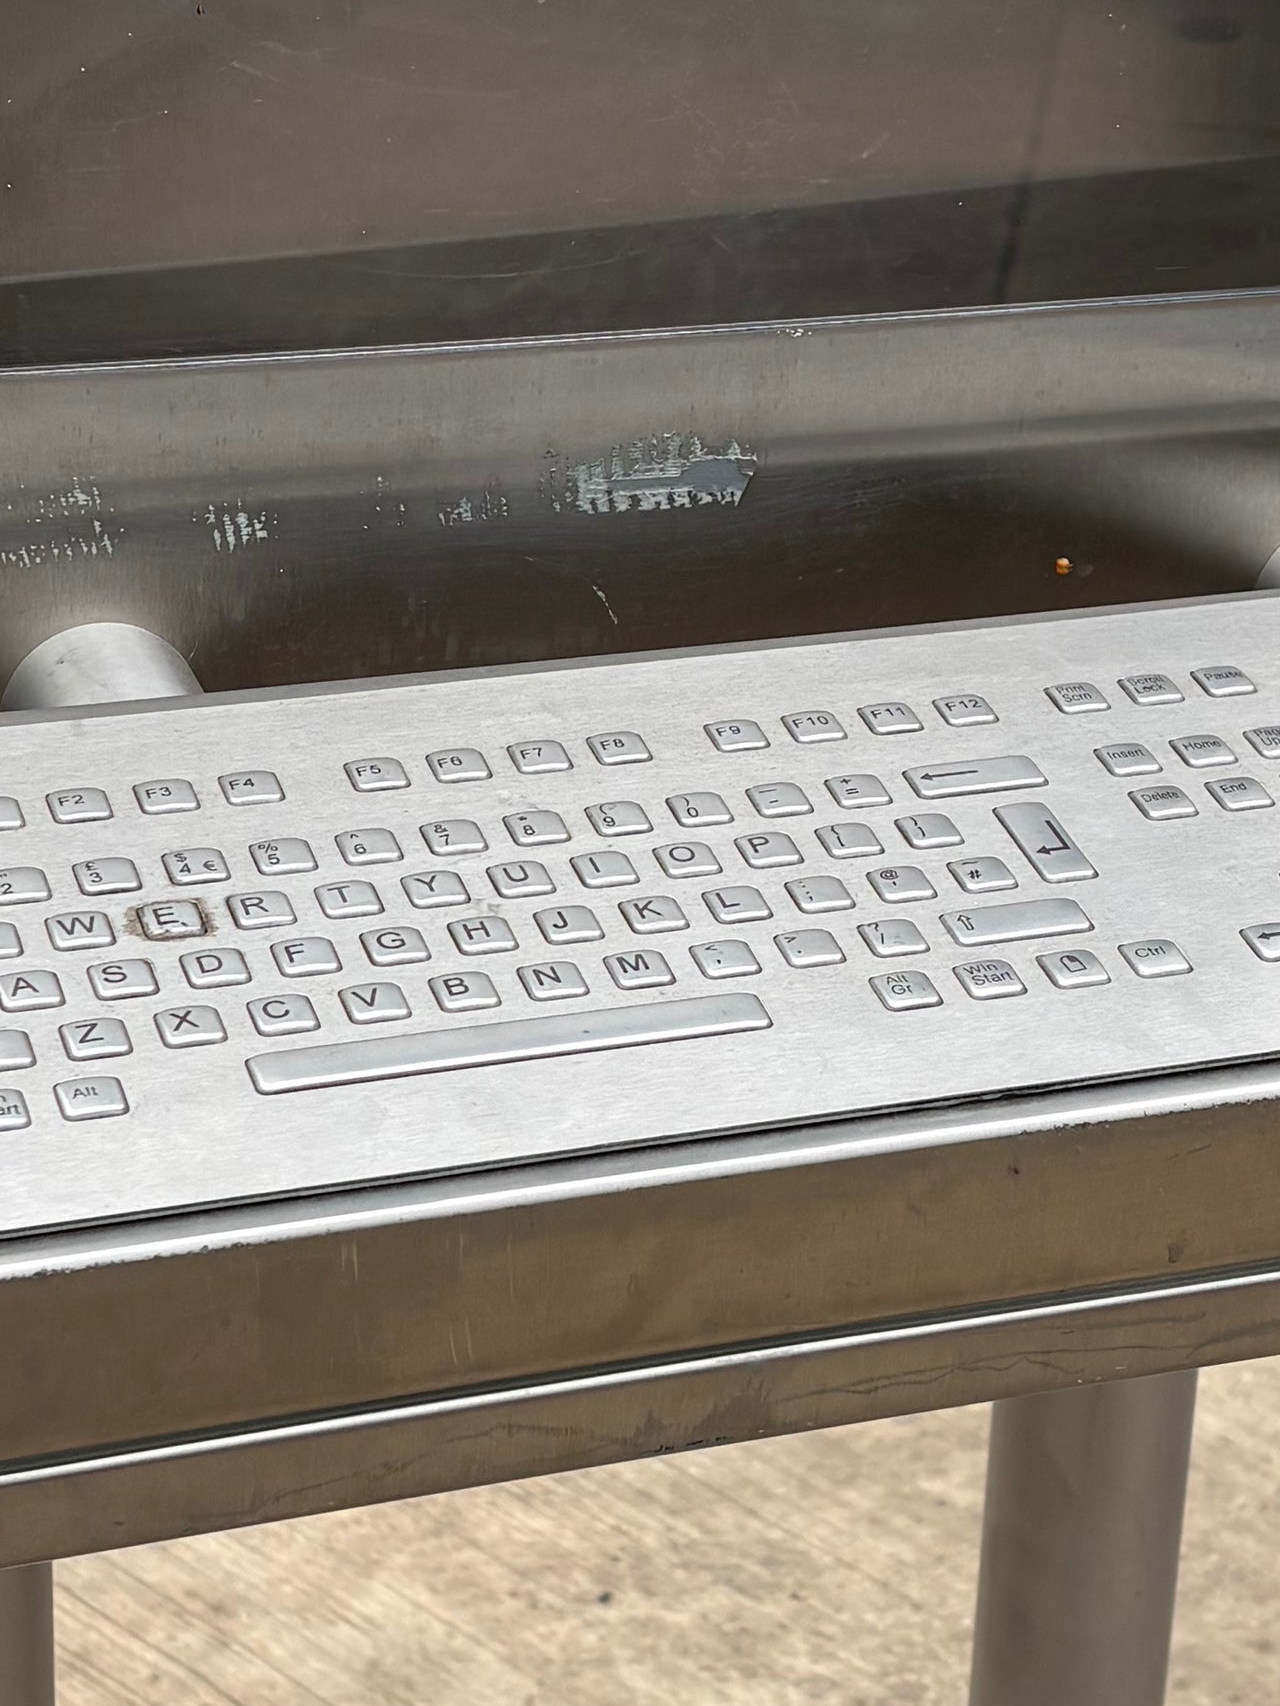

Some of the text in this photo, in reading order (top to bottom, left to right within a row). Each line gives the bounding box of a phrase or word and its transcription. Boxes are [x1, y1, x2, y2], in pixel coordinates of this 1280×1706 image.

[1127, 676, 1164, 686] Scroll
[1203, 670, 1240, 681] Pause
[1055, 685, 1085, 695] Print
[1134, 683, 1167, 694] Lock
[1062, 692, 1092, 703] Scrn
[945, 699, 982, 711] F12
[871, 707, 906, 719] F11
[792, 716, 829, 729] F10
[716, 726, 740, 737] F9
[600, 739, 625, 750] F8
[1182, 740, 1221, 751] Home
[1263, 736, 1280, 747] Up
[520, 748, 542, 759] F7
[1107, 749, 1143, 760] Insert
[437, 756, 462, 768] F6
[355, 765, 381, 777] F5
[229, 778, 254, 790] F4
[1222, 782, 1246, 793] End
[146, 787, 171, 799] F3
[1141, 791, 1179, 803] Delete
[58, 795, 84, 806] F2
[687, 807, 698, 817] 0
[603, 817, 616, 827] 9
[434, 824, 447, 833] &
[523, 825, 535, 835] 8
[439, 834, 450, 845] 7
[748, 836, 769, 853] P
[258, 844, 277, 853] %
[354, 844, 366, 854] 6
[670, 846, 695, 862] O
[174, 853, 187, 862] $
[268, 854, 280, 865] 5
[85, 862, 96, 871] £
[180, 860, 217, 874] 4 €
[588, 857, 601, 872] I
[89, 873, 103, 883] 3
[503, 865, 529, 882] U
[880, 870, 898, 880] @
[967, 869, 981, 879] #
[0, 883, 14, 895] 2
[416, 875, 437, 892] Y
[327, 886, 351, 903] T
[715, 892, 741, 908] L
[240, 897, 269, 915] R
[633, 900, 662, 919] K
[152, 906, 179, 925] E
[552, 911, 569, 929] J
[56, 916, 95, 936] W
[462, 921, 491, 940] H
[870, 922, 879, 931] ?
[377, 932, 405, 949] G
[284, 943, 305, 963] F
[1135, 945, 1166, 958] Ctrl
[196, 955, 223, 973] D
[615, 954, 650, 974] M
[963, 962, 997, 974] Win
[102, 966, 127, 983] S
[532, 966, 562, 986] N
[886, 974, 908, 985] Alt
[971, 972, 1013, 986] Start
[12, 977, 40, 997] A
[442, 977, 469, 995] B
[891, 982, 911, 995] Gr
[351, 988, 377, 1007] V
[262, 1000, 290, 1018] C
[170, 1010, 200, 1031] X
[75, 1023, 104, 1043] Z
[72, 1086, 97, 1099] Alt
